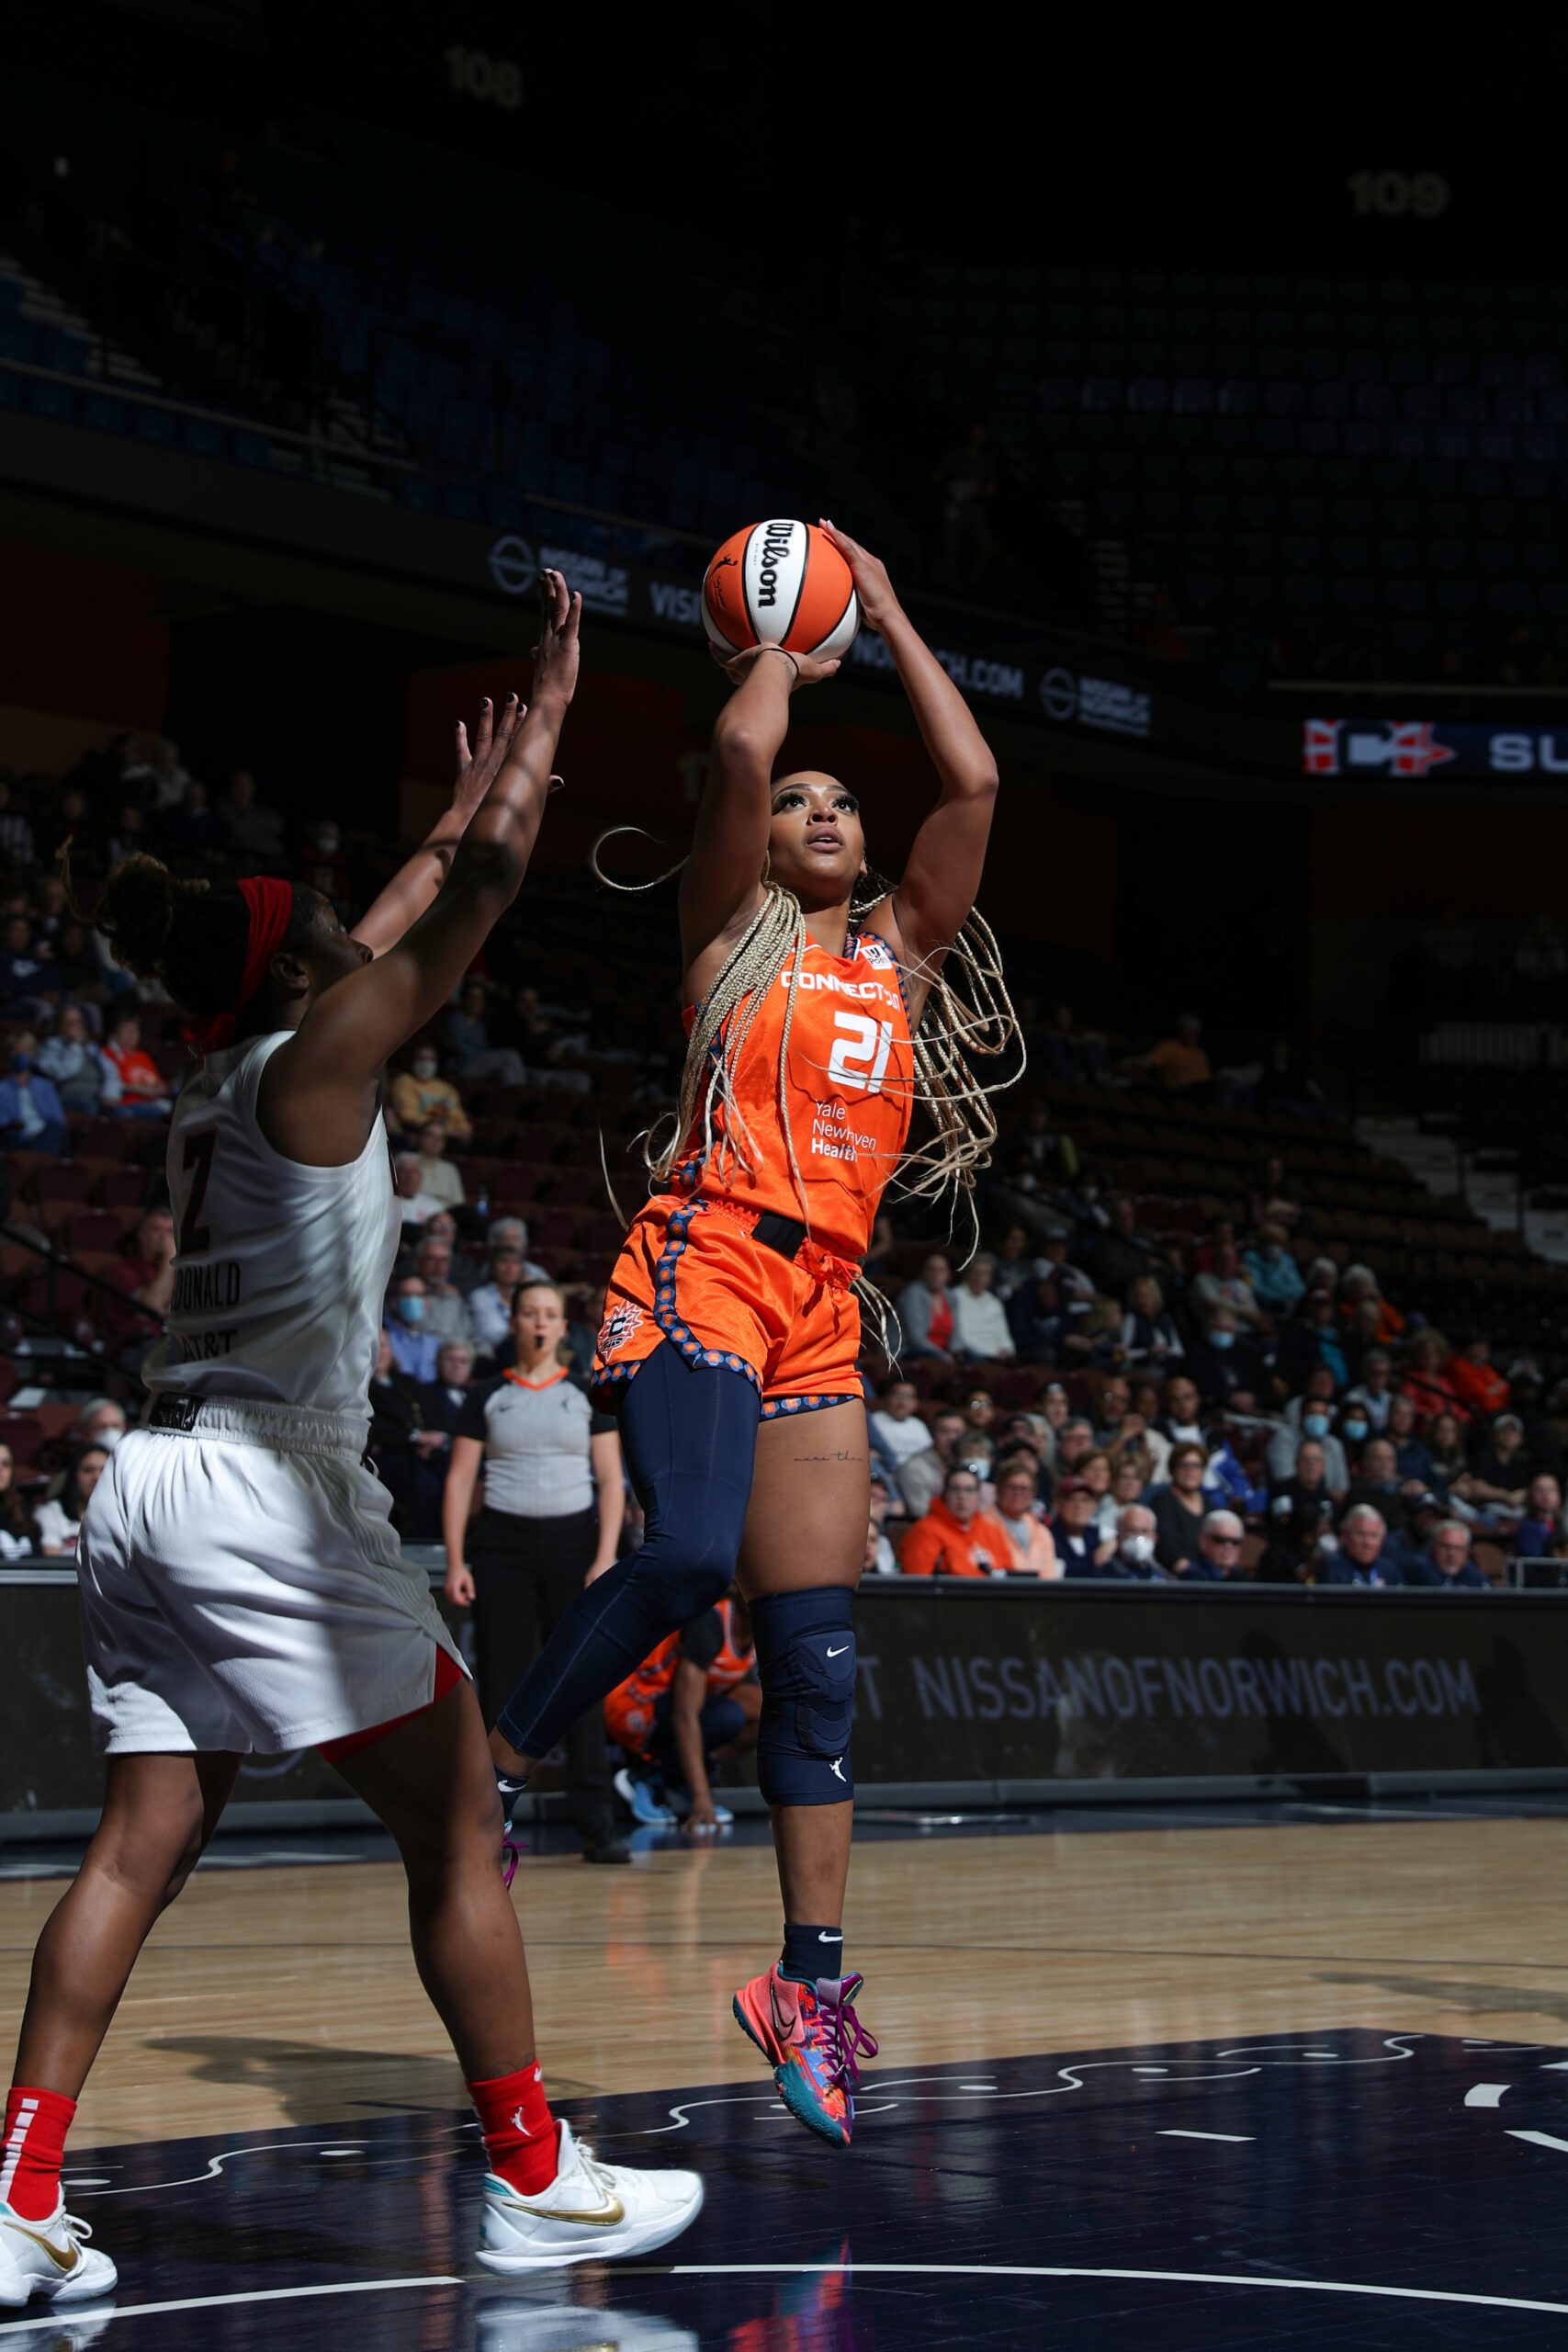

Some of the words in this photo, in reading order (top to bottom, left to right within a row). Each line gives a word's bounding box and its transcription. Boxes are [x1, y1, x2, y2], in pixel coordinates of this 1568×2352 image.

[442, 44, 525, 110] 108
[1345, 169, 1452, 219] 109
[758, 522, 794, 608] Wilson
[829, 1011, 893, 1094] 21
[812, 1118, 876, 1152] Newven
[815, 1099, 846, 1120] Yale
[811, 1137, 858, 1162] Health
[181, 1131, 215, 1254] 2
[183, 1329, 237, 1363] AT&T
[911, 1655, 1483, 1721] NISSANOFNORWICH.COM
